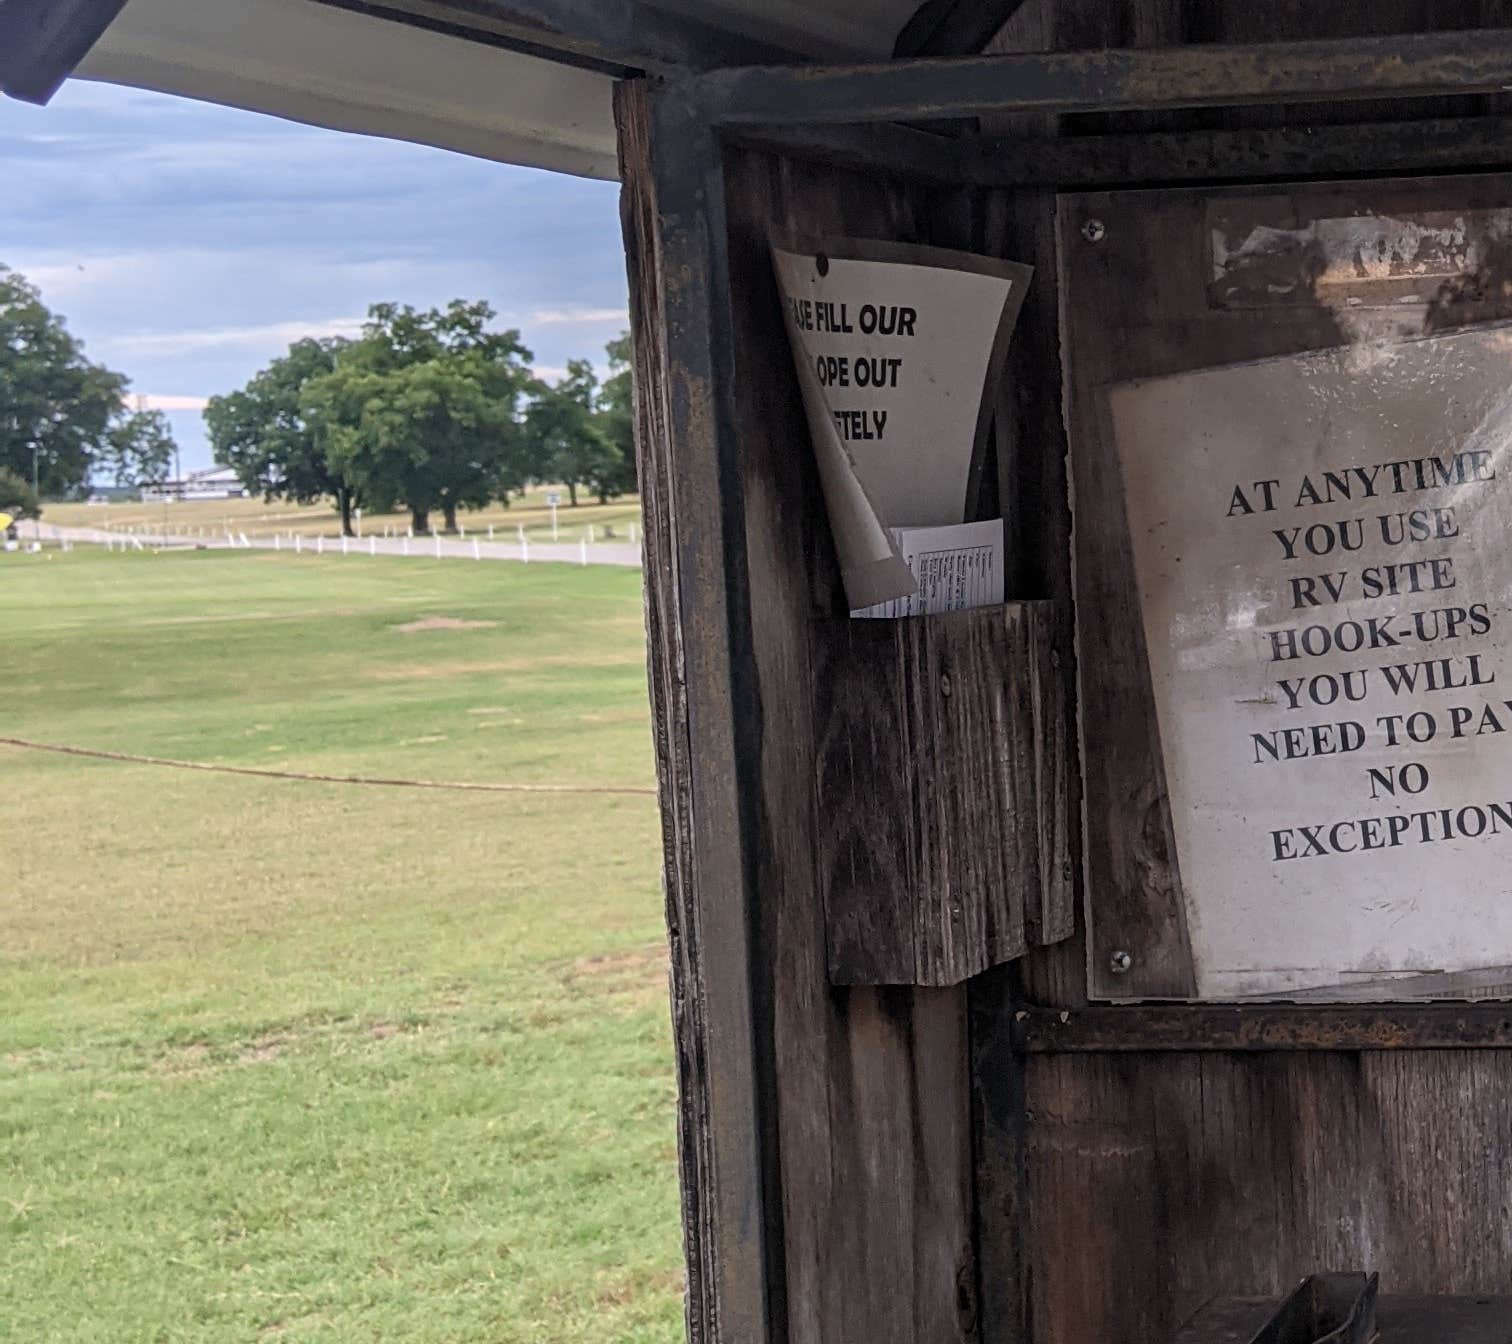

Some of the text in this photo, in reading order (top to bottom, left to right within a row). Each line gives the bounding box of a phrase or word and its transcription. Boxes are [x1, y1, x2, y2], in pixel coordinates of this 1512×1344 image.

[815, 301, 853, 333] FILL
[859, 305, 917, 336] OUR
[817, 355, 902, 387] OPE OUT
[1224, 449, 1497, 517] AT ANYTIME
[1272, 506, 1460, 561] YOU USE
[1287, 557, 1457, 609] RV SITE
[1266, 603, 1492, 662] HOOK-UPS
[1277, 654, 1496, 711] YOU WILL
[1250, 721, 1367, 765] NEED
[1376, 710, 1437, 748] TO
[1366, 761, 1430, 800] NO
